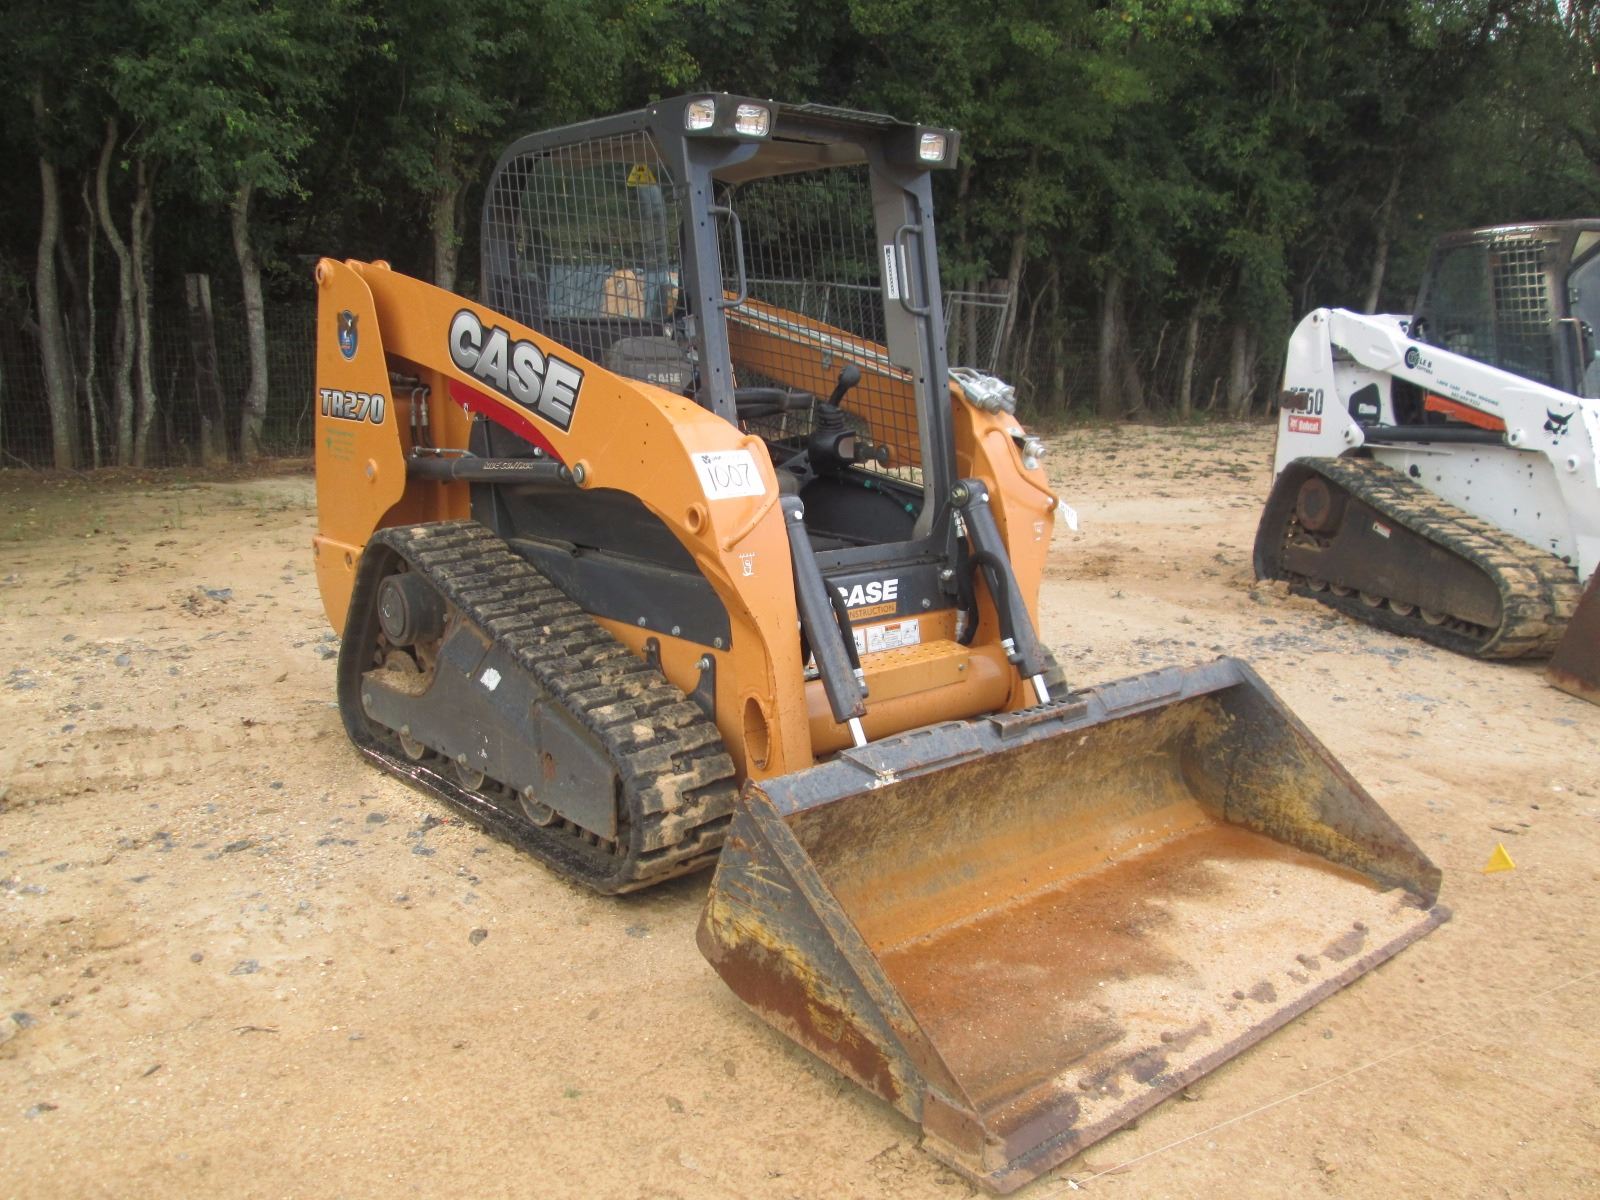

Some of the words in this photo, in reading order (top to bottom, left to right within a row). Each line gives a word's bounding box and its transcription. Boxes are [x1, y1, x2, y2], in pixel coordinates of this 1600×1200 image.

[449, 309, 584, 434] CASE
[319, 388, 385, 425] TR270
[1290, 387, 1324, 415] 50
[707, 463, 752, 491] 1007
